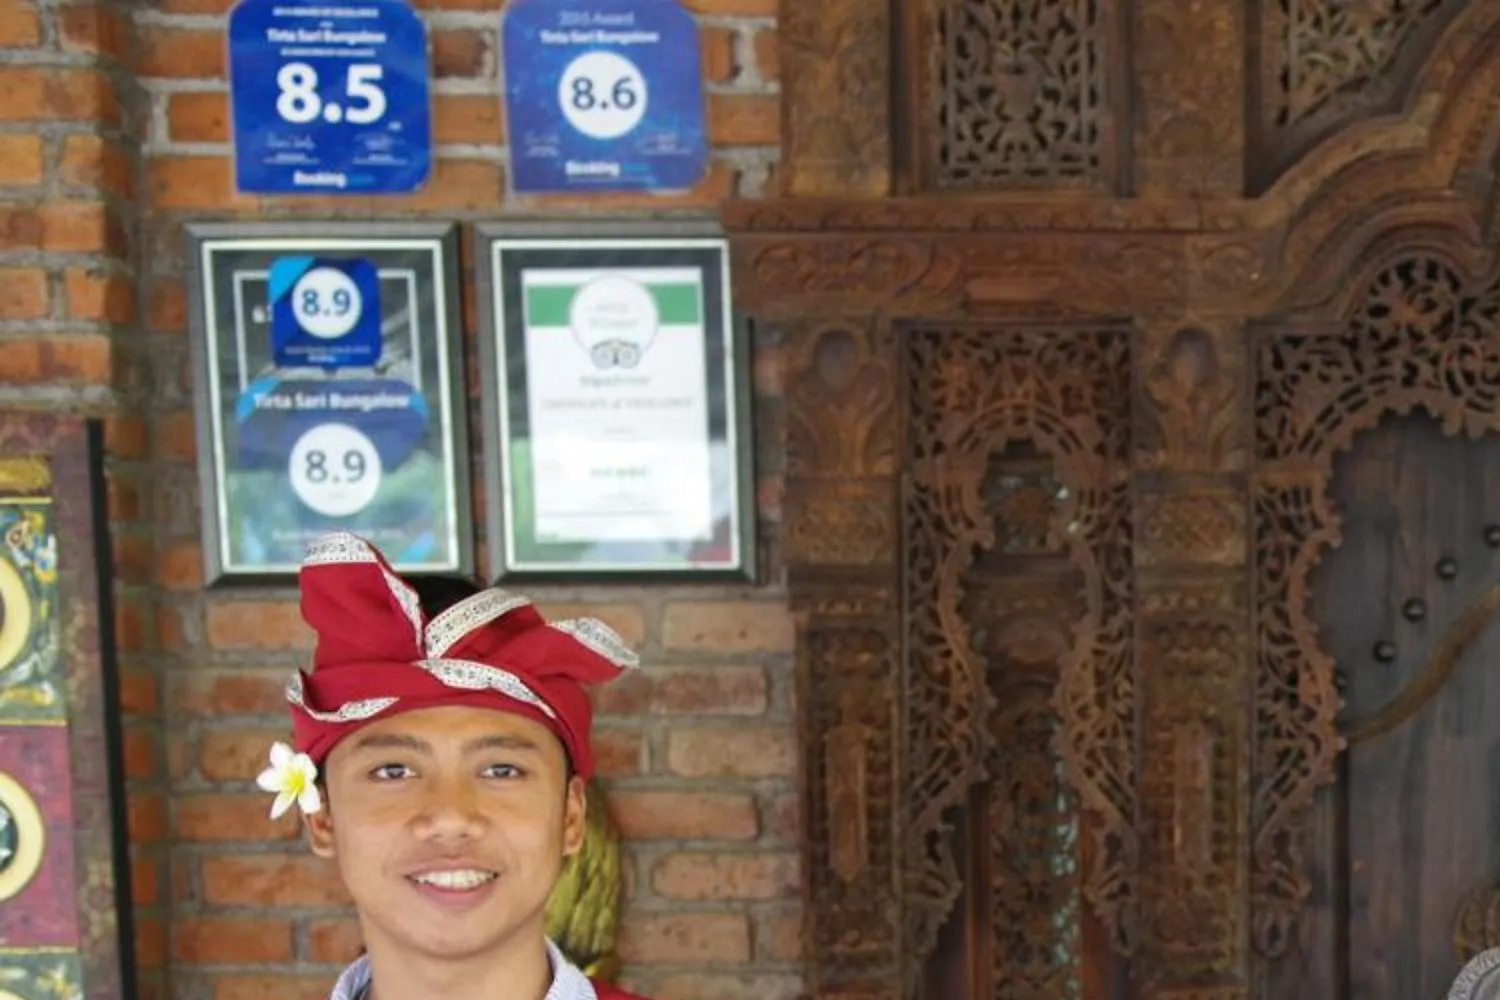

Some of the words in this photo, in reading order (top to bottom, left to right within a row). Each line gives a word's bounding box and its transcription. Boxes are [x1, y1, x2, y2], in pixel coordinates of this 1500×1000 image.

[276, 62, 387, 124] 8.5
[571, 77, 637, 110] 8.6
[302, 288, 351, 316] 8.9
[253, 393, 292, 409] Tirta
[295, 393, 326, 409] Sari
[329, 392, 410, 412] Bungalow
[305, 450, 367, 483] 8.9
